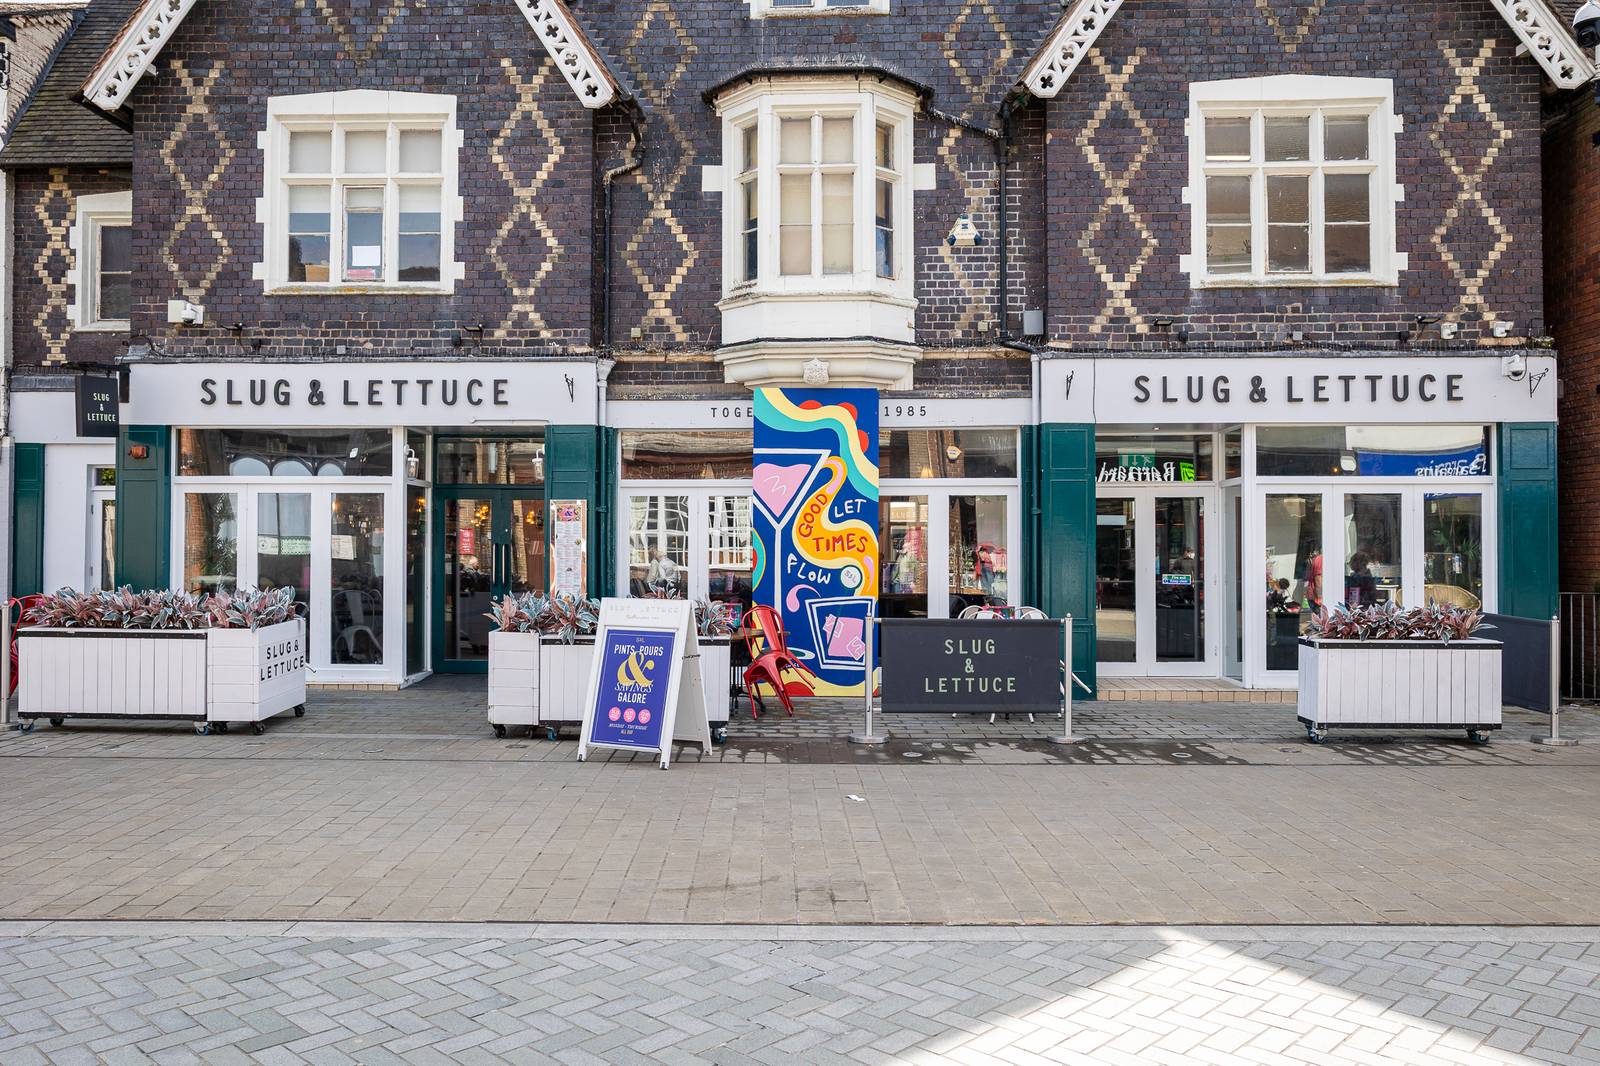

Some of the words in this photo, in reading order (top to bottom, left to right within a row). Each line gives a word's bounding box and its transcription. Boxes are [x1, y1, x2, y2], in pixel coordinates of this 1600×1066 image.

[93, 392, 110, 401] SLUG
[200, 378, 291, 406] SLUG
[308, 379, 326, 406] &
[343, 379, 509, 406] LETTUCE
[1134, 375, 1230, 403] SLUG
[1249, 375, 1268, 403] &
[1287, 374, 1464, 402] LETTUCE
[99, 403, 104, 411] &
[884, 406, 927, 417] 1985
[87, 413, 116, 422] LETTUCE
[798, 493, 829, 538] GOOD
[834, 498, 867, 518] LET
[812, 533, 868, 553] TIMES
[787, 553, 831, 585] FLOW
[267, 641, 291, 660] SLUG
[294, 640, 298, 651] &
[614, 644, 636, 655] PINTS
[640, 645, 664, 656] POURS
[945, 639, 996, 655] SLUG
[260, 655, 304, 681] LETTUCE
[617, 650, 655, 688] &
[964, 658, 975, 673] &
[614, 682, 654, 694] SAVINGS
[925, 677, 1016, 693] LETTUCE
[617, 692, 648, 704] GALORE
